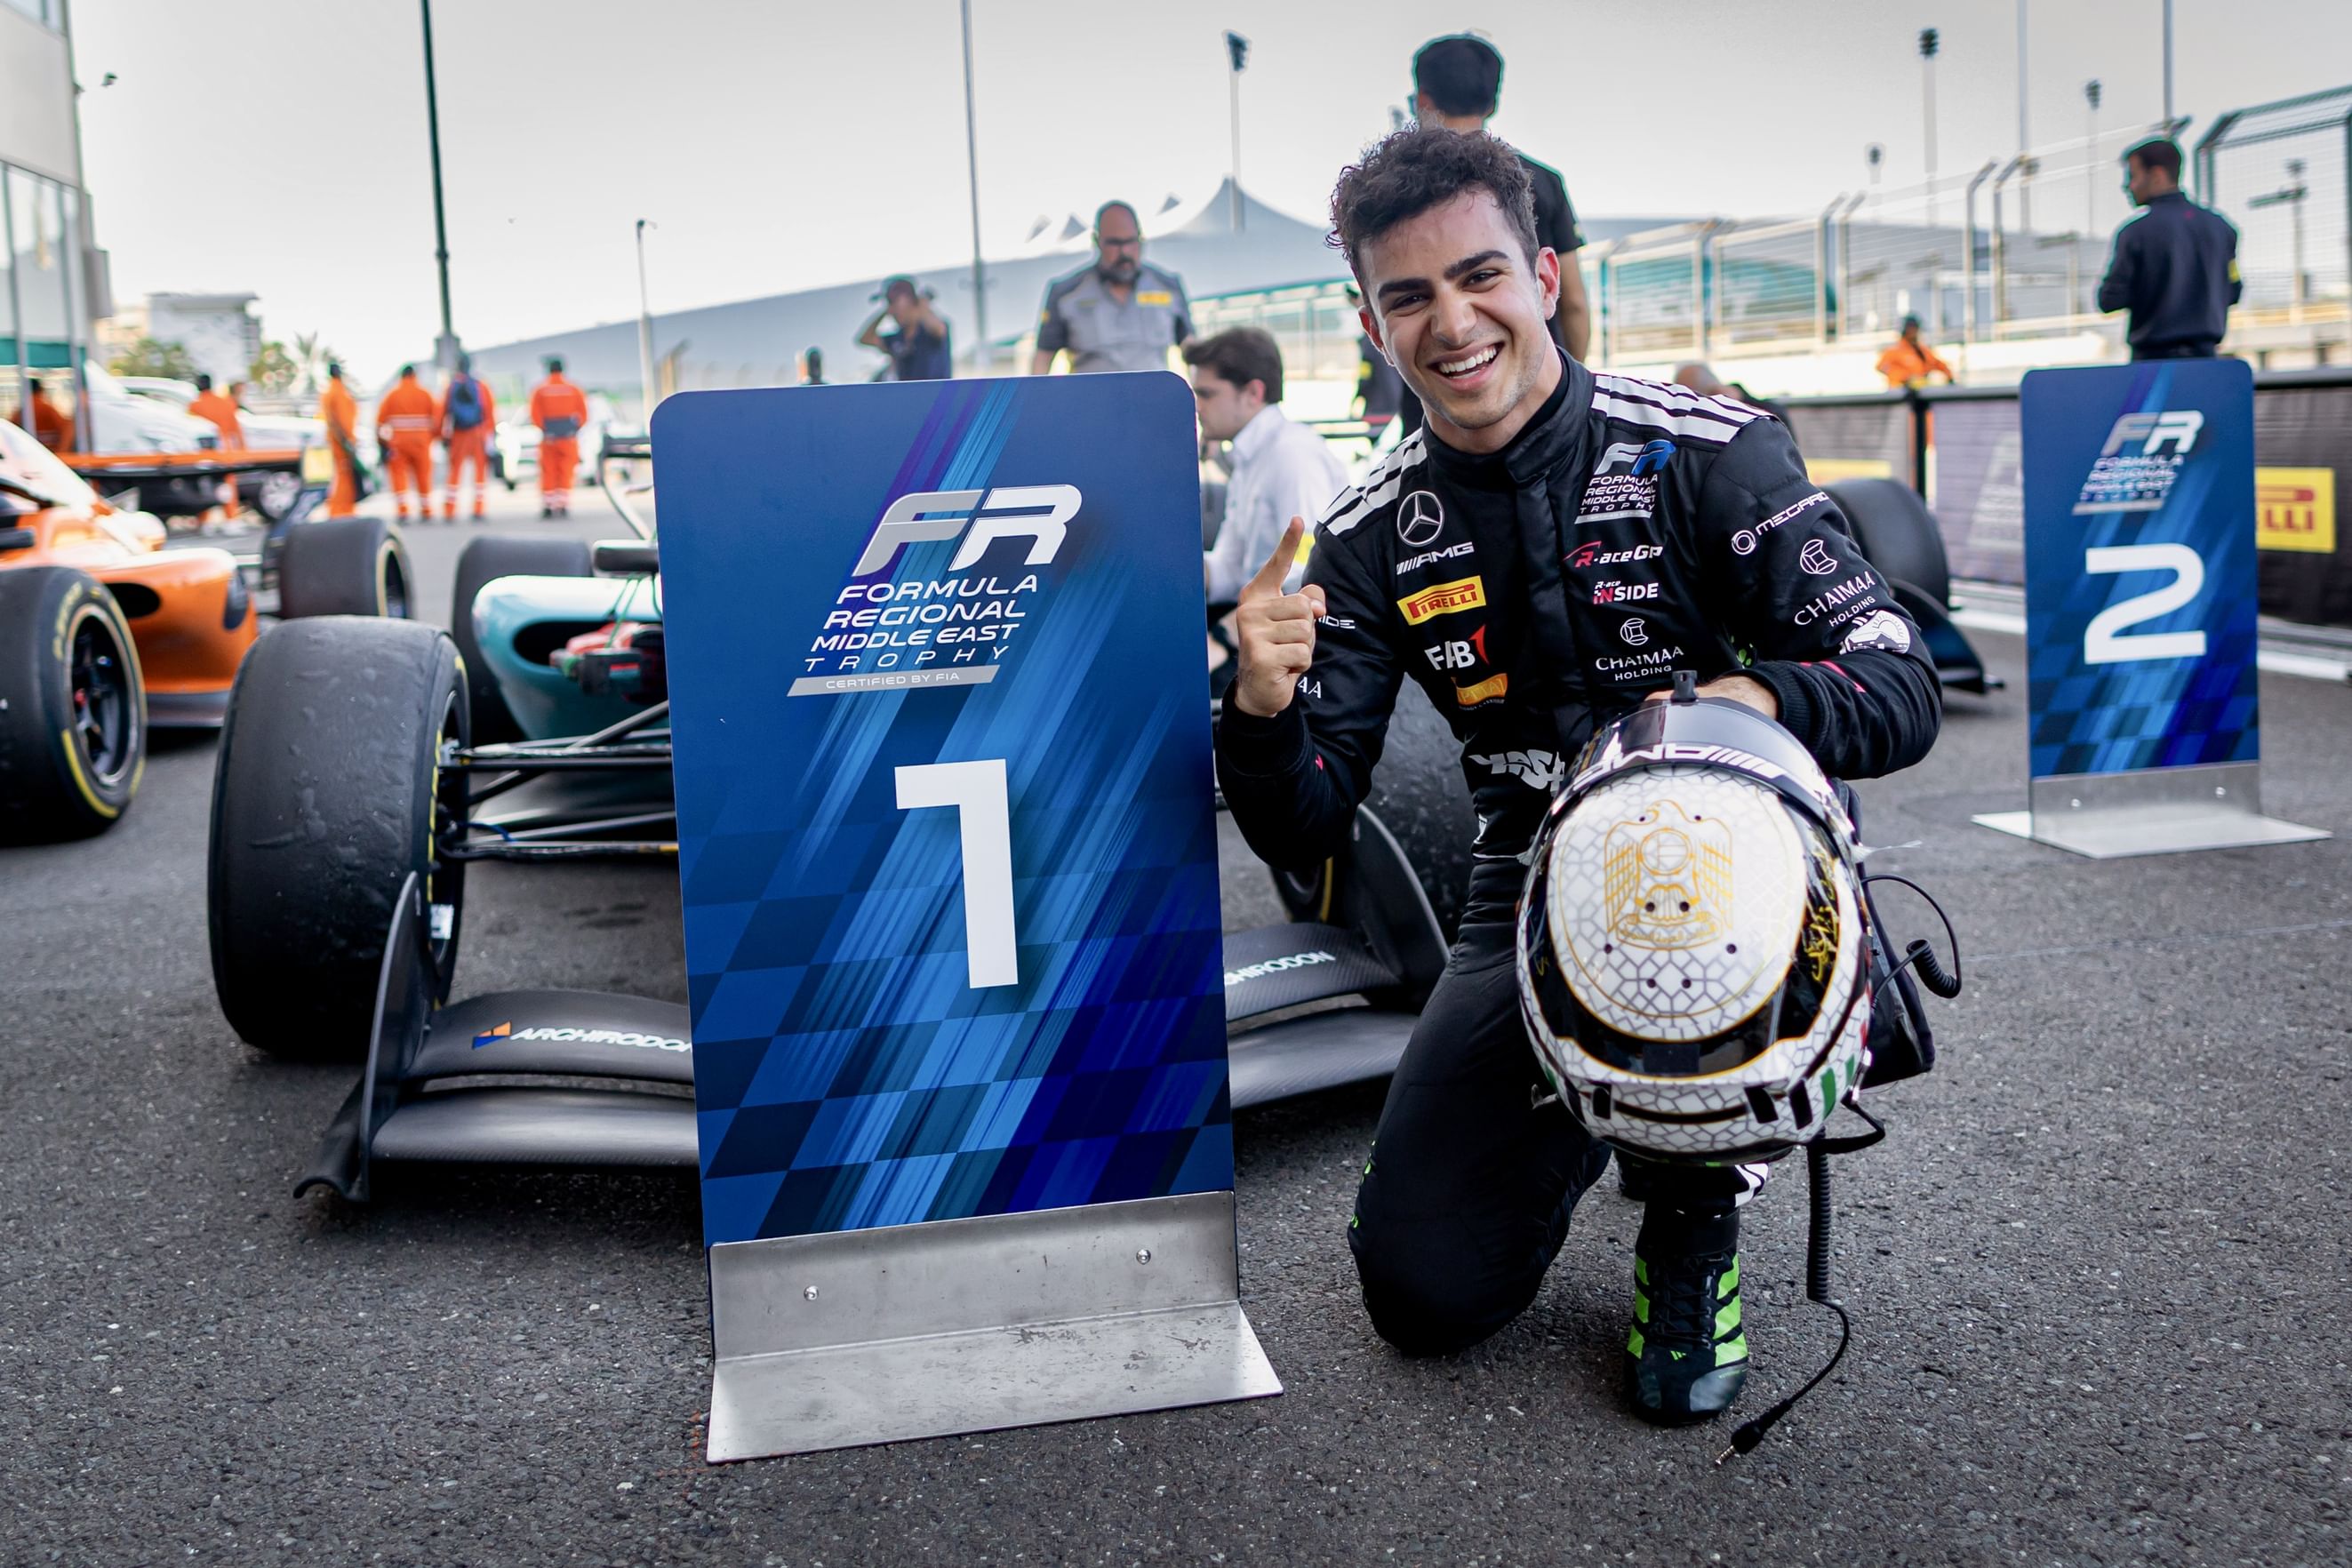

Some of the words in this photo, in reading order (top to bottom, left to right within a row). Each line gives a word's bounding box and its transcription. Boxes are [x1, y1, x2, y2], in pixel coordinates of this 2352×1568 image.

[2100, 410, 2204, 456] FR
[1594, 439, 1676, 476] FR
[1585, 484, 1657, 497] REGIONAL
[1589, 474, 1658, 486] FORMULA
[1580, 502, 1655, 514] TROPHY
[1582, 494, 1628, 506] MIDDLE
[1629, 493, 1656, 503] EAST
[852, 484, 1082, 577] FR
[836, 575, 1038, 604] FORMULA
[1407, 583, 1478, 619] PIRELLI
[1794, 572, 1876, 625] CHAIMAA
[2084, 543, 2206, 665] 2
[823, 600, 1026, 629] REGIONAL
[1828, 596, 1876, 627] HOLDING
[811, 629, 932, 652] MIDDLE
[936, 623, 1020, 644] EAST
[804, 645, 1009, 672] TROPHY
[1596, 646, 1684, 670] CHAIMAA
[826, 676, 906, 689] CERTIFIED
[911, 675, 931, 684] BY
[936, 672, 960, 682] FIA
[1615, 665, 1672, 681] HOLDING
[894, 758, 1019, 988] 1
